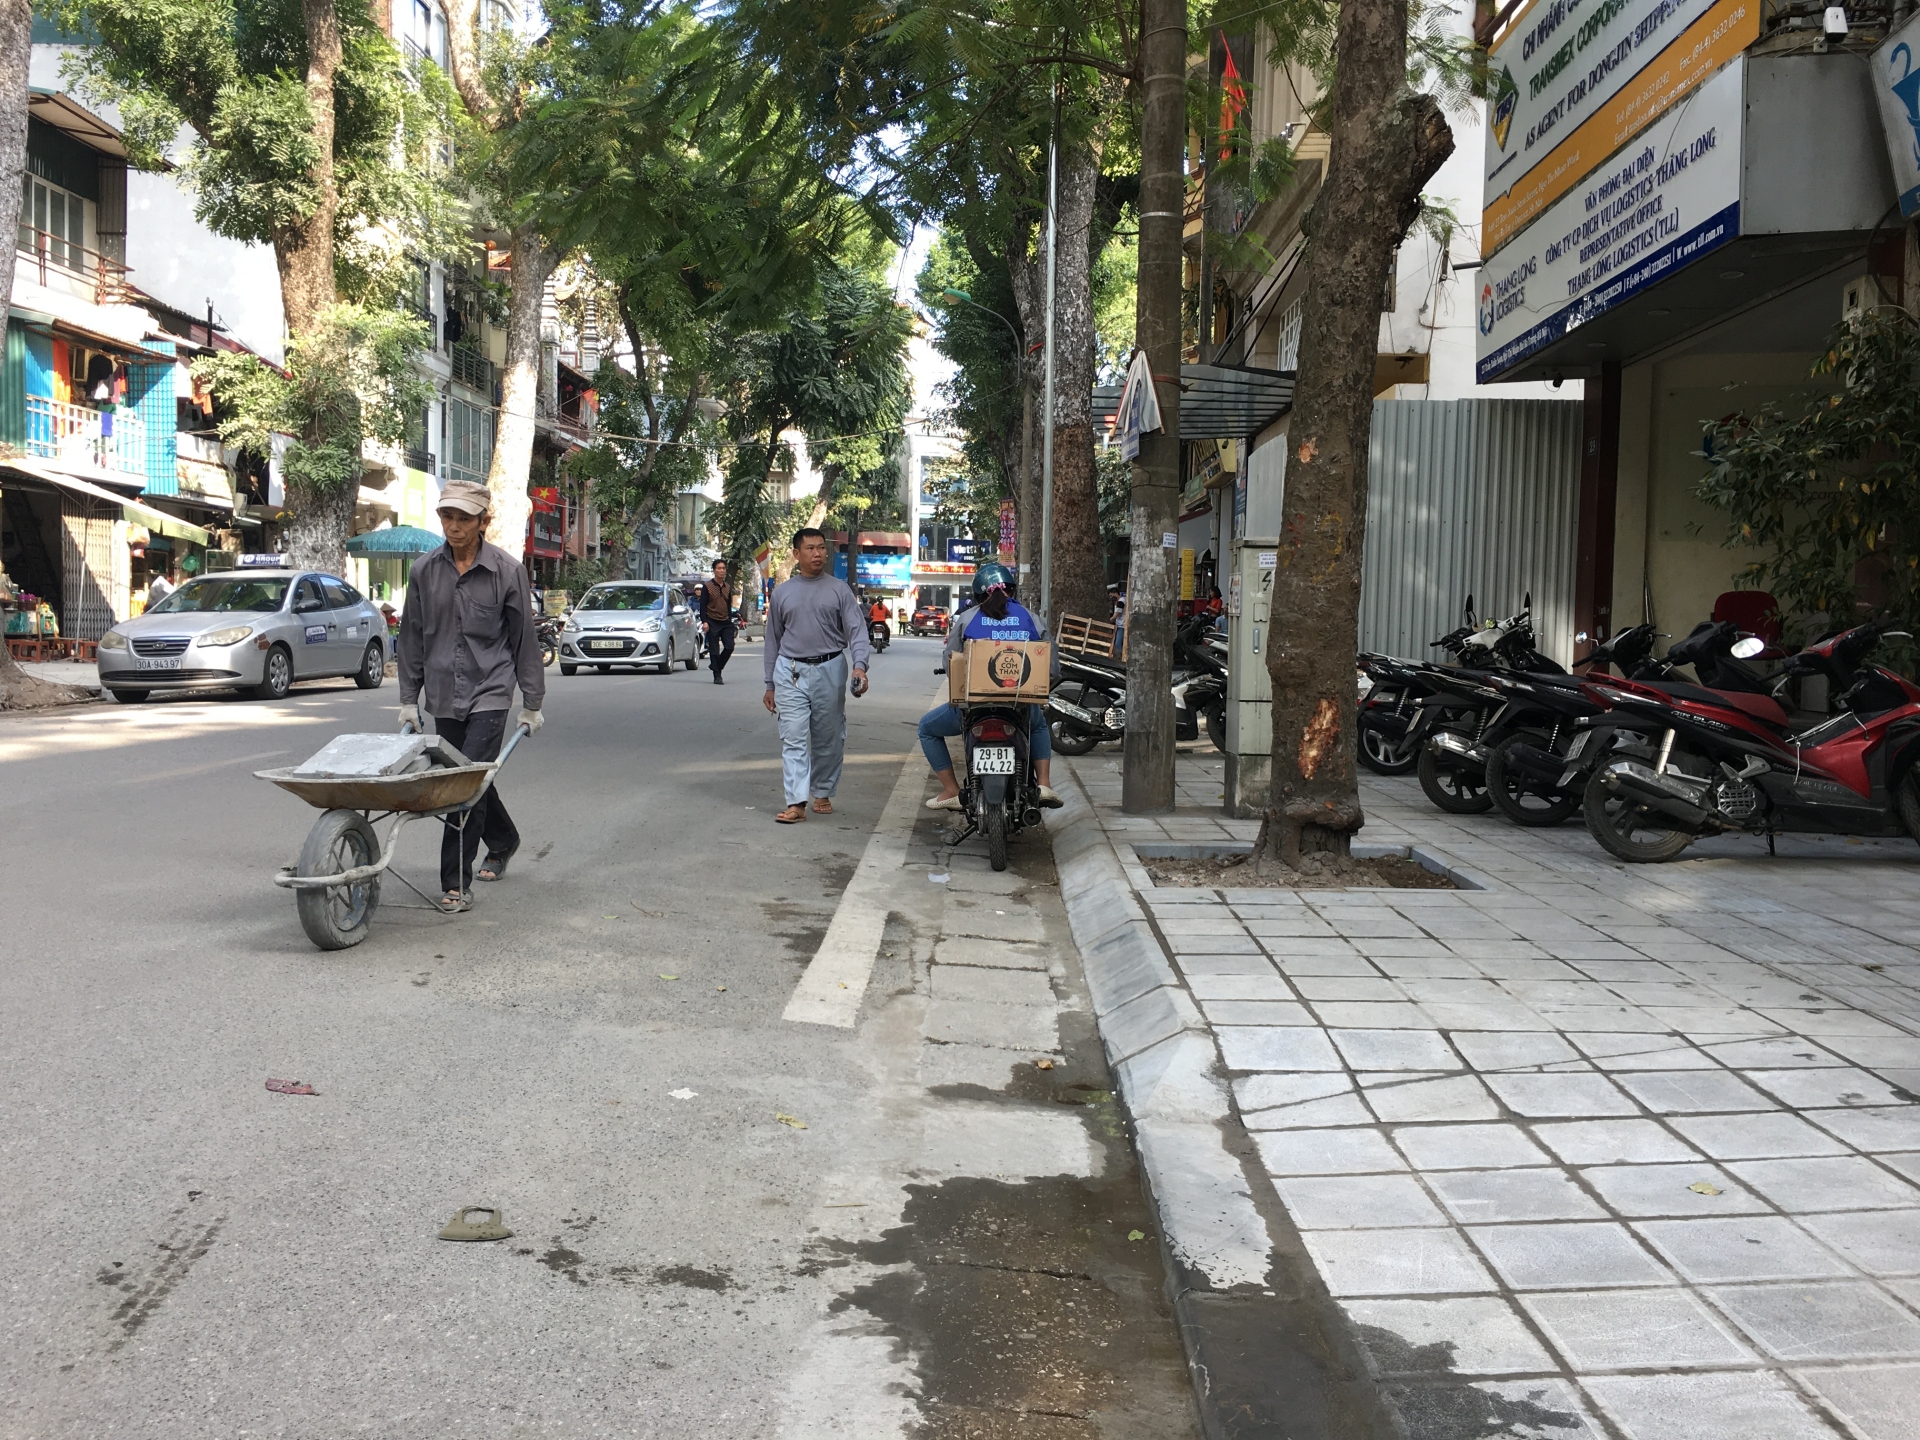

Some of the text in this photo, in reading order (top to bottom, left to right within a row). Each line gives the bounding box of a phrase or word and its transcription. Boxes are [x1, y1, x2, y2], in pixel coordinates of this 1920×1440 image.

[1522, 29, 1536, 61] CHI
[1711, 20, 1728, 44] 3632
[1529, 34, 1575, 101] TRANSIMEX
[1525, 126, 1536, 151] AS
[1536, 97, 1566, 140] AGENT
[1567, 79, 1587, 112] FOR
[1588, 31, 1634, 92] DONGJIN
[1545, 127, 1716, 265] CÔNG TY CP DỊCH VỤ LOGISTICS THĂNG LONG
[1585, 146, 1655, 212] VĂN PHÒNG ĐẠI DIỆN
[1580, 194, 1663, 265] REPRESENTATIVE OFFICE
[1568, 207, 1679, 296] THANG LONG LOGISTICS (TLL)
[1496, 255, 1537, 299] THANG LONG
[1496, 286, 1525, 321] LOGISTICS
[982, 616, 1020, 626] BIGGER
[992, 631, 1030, 640] BOLDER
[137, 660, 180, 670] 30A-943.97
[976, 760, 1012, 773] 444.22
[979, 748, 1008, 760] 29-B1
